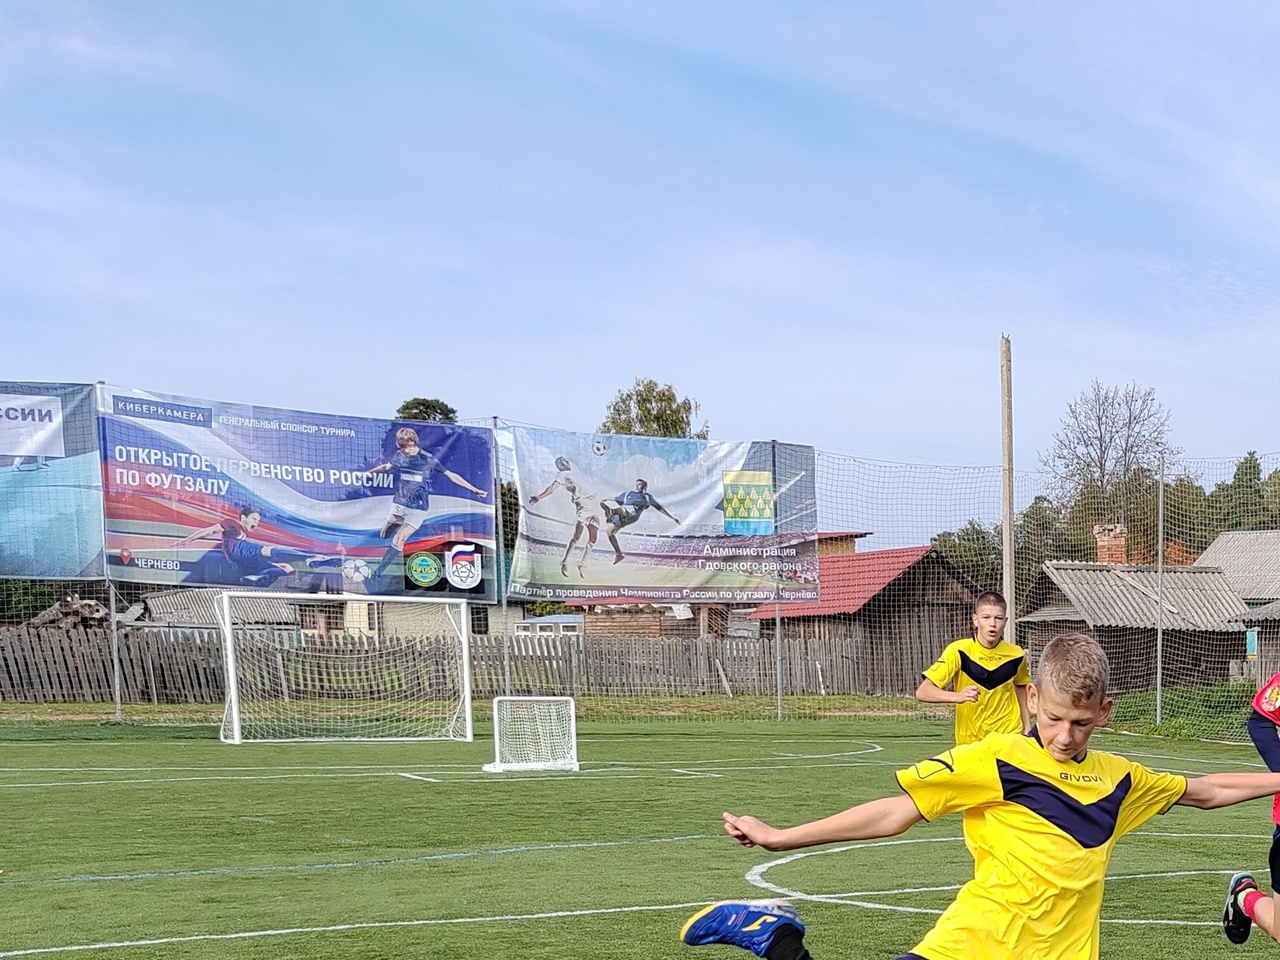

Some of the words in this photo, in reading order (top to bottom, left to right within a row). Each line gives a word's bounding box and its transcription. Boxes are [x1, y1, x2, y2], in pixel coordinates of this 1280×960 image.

[118, 402, 204, 421] КИБЕРКАМЕРА
[219, 416, 279, 430] ГЕНЕРАЛЬНЫЙ
[281, 423, 318, 434] СПОНСОР
[320, 427, 356, 438] ТУРНИРА
[115, 445, 211, 472] ОТКРЫТОЕ
[217, 459, 325, 483] ПЕРВЕНСТВО
[330, 470, 394, 489] РОССИИ
[115, 468, 140, 486] ПО
[145, 472, 230, 495] ФУТЗАЛУ
[703, 545, 796, 558] Администрация
[134, 557, 181, 570] ЧЕРНЕВО
[698, 559, 760, 572] Гдовского
[510, 582, 553, 597] Партнёр
[555, 588, 618, 598] проведения
[620, 588, 681, 599] Чемпионата
[683, 589, 717, 599] России
[719, 590, 732, 599] по
